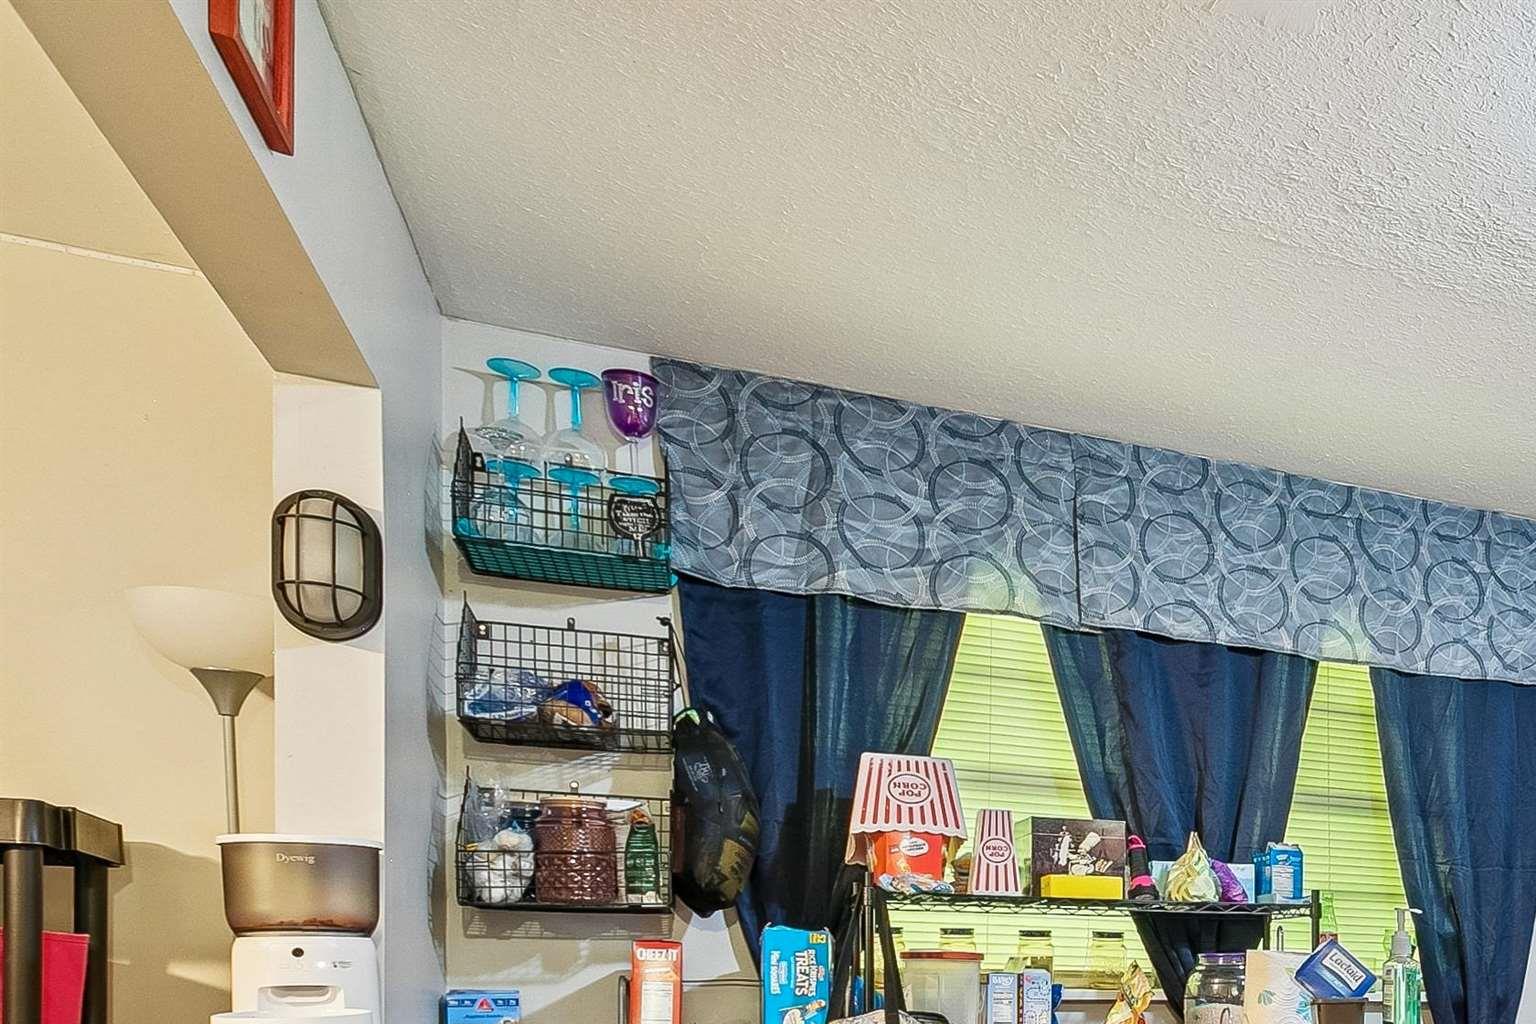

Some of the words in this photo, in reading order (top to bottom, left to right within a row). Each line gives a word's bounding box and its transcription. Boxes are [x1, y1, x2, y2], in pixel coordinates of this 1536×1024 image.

[892, 781, 927, 791] CORN
[898, 788, 922, 797] POP
[794, 950, 809, 996] TREATS
[1328, 952, 1364, 983] Lactaid
